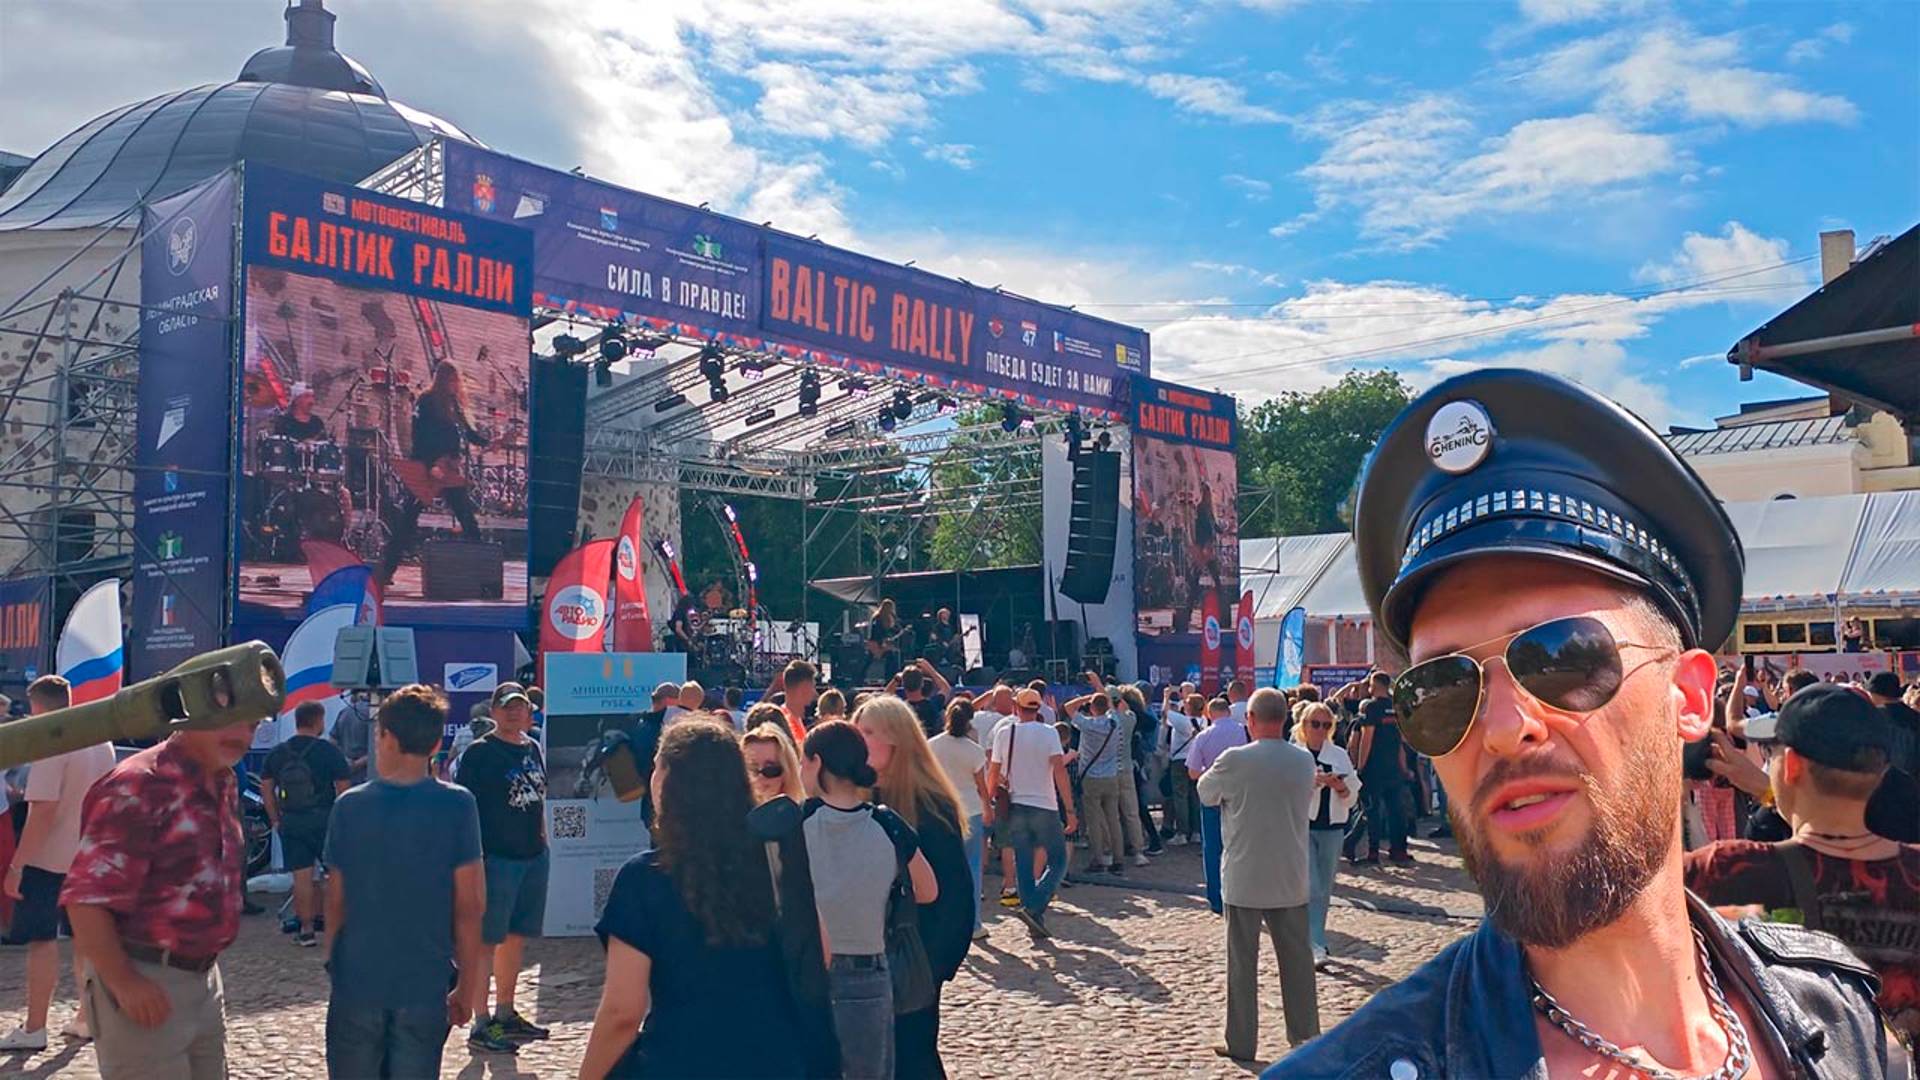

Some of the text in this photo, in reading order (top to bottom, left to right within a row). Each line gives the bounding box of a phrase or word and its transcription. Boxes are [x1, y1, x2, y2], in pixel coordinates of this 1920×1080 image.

[351, 199, 466, 243] МОТОФЕСТИВАЛЬ
[269, 211, 513, 304] БАЛТИК РАЛЛИ
[608, 263, 652, 299] СИЛА
[662, 276, 671, 302] В
[680, 281, 746, 320] ПРАВДЕ!
[771, 257, 974, 366] BALTIC RALLY
[1022, 331, 1036, 347] 47
[986, 351, 1112, 397] ПОБЕДА БУДЕТ ЗА НАМИ!
[1139, 401, 1230, 445] БАЛТИК РАЛЛИ
[0, 602, 40, 649] ЛЛИ
